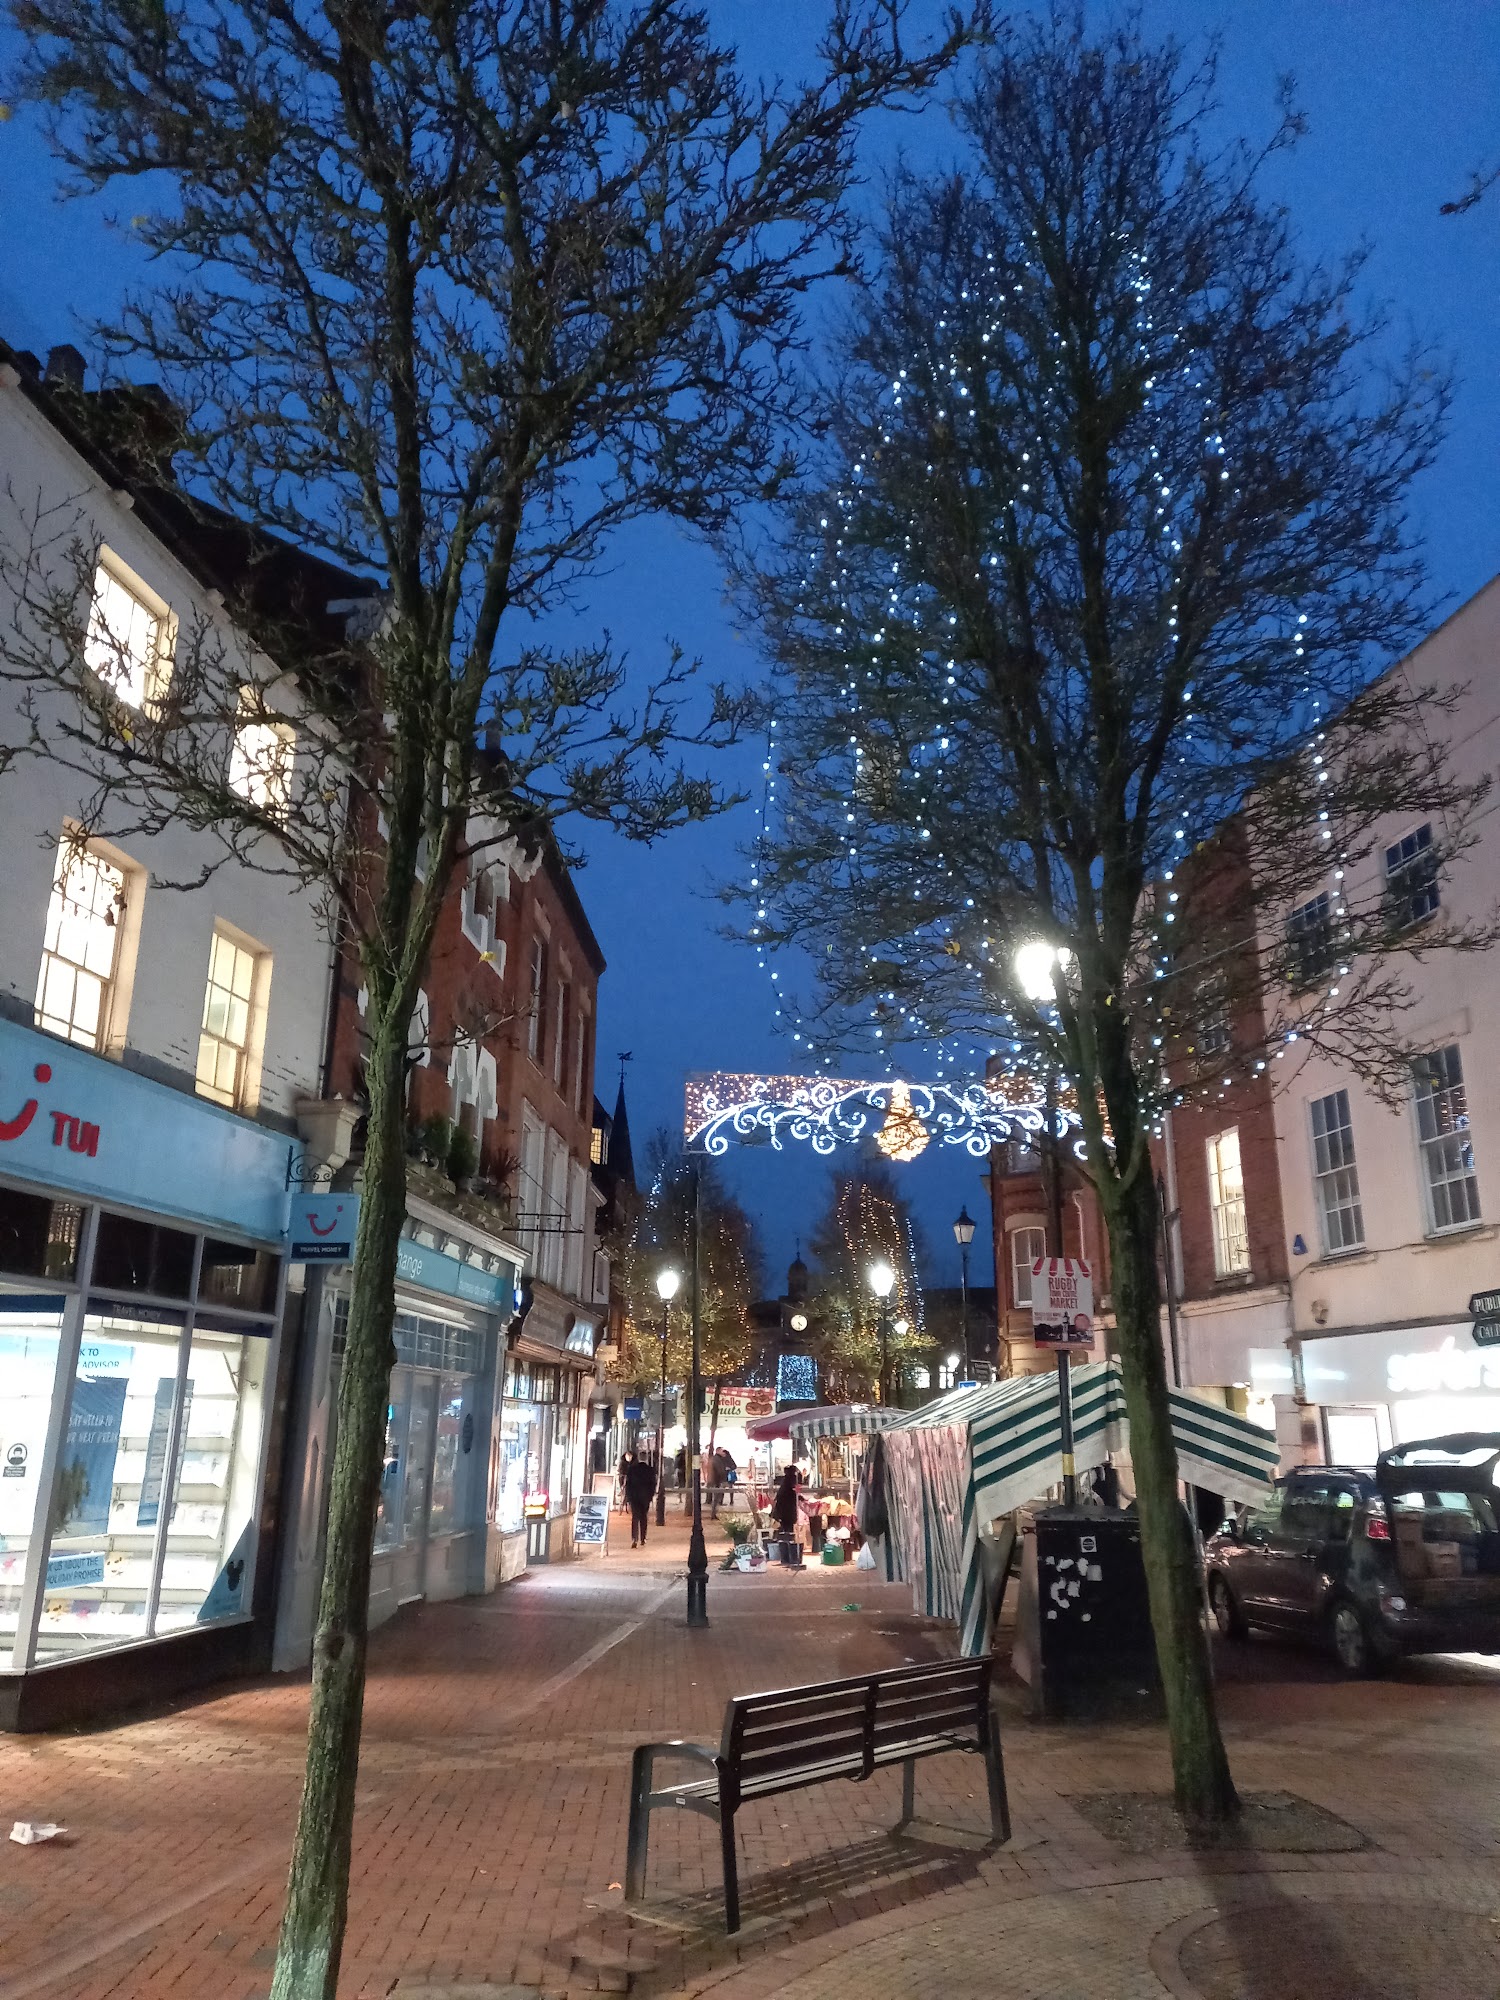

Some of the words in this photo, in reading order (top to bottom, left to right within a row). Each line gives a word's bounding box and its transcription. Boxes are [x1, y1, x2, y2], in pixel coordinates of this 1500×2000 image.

[49, 1110, 100, 1157] TUI
[397, 1248, 423, 1279] hange
[1048, 1277, 1078, 1290] RUGBY
[1050, 1297, 1078, 1309] MARKET
[82, 1360, 120, 1369] ADVISOR
[710, 1397, 741, 1406] ntella
